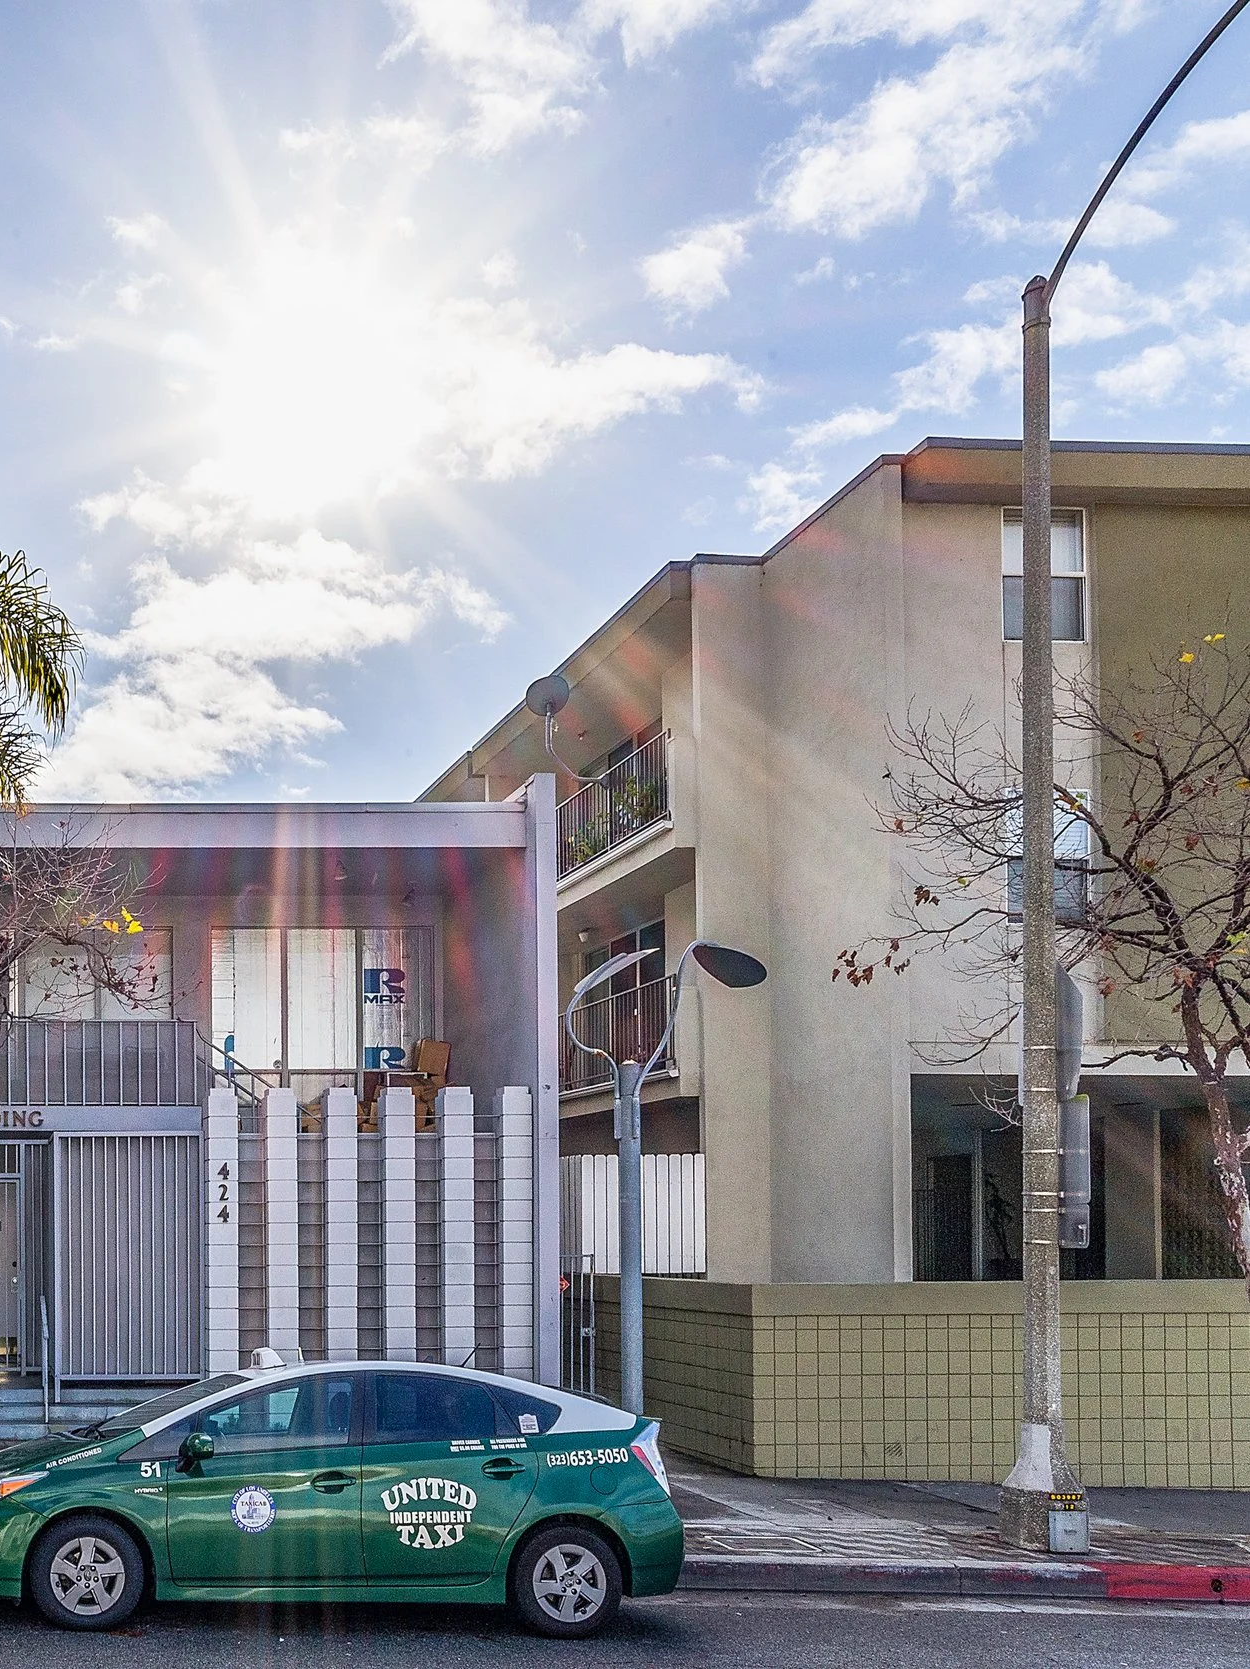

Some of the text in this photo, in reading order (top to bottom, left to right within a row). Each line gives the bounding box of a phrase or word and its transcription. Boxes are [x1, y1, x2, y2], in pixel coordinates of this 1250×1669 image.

[364, 995, 406, 1004] MAX
[217, 1161, 230, 1223] 424
[46, 1447, 103, 1470] AIR CONDITIONED
[547, 1447, 629, 1468] (323)653-5050
[140, 1461, 161, 1478] 51
[380, 1477, 477, 1511] UNITED
[390, 1510, 472, 1524] INDEPENDENT
[396, 1524, 465, 1549] TAXI
